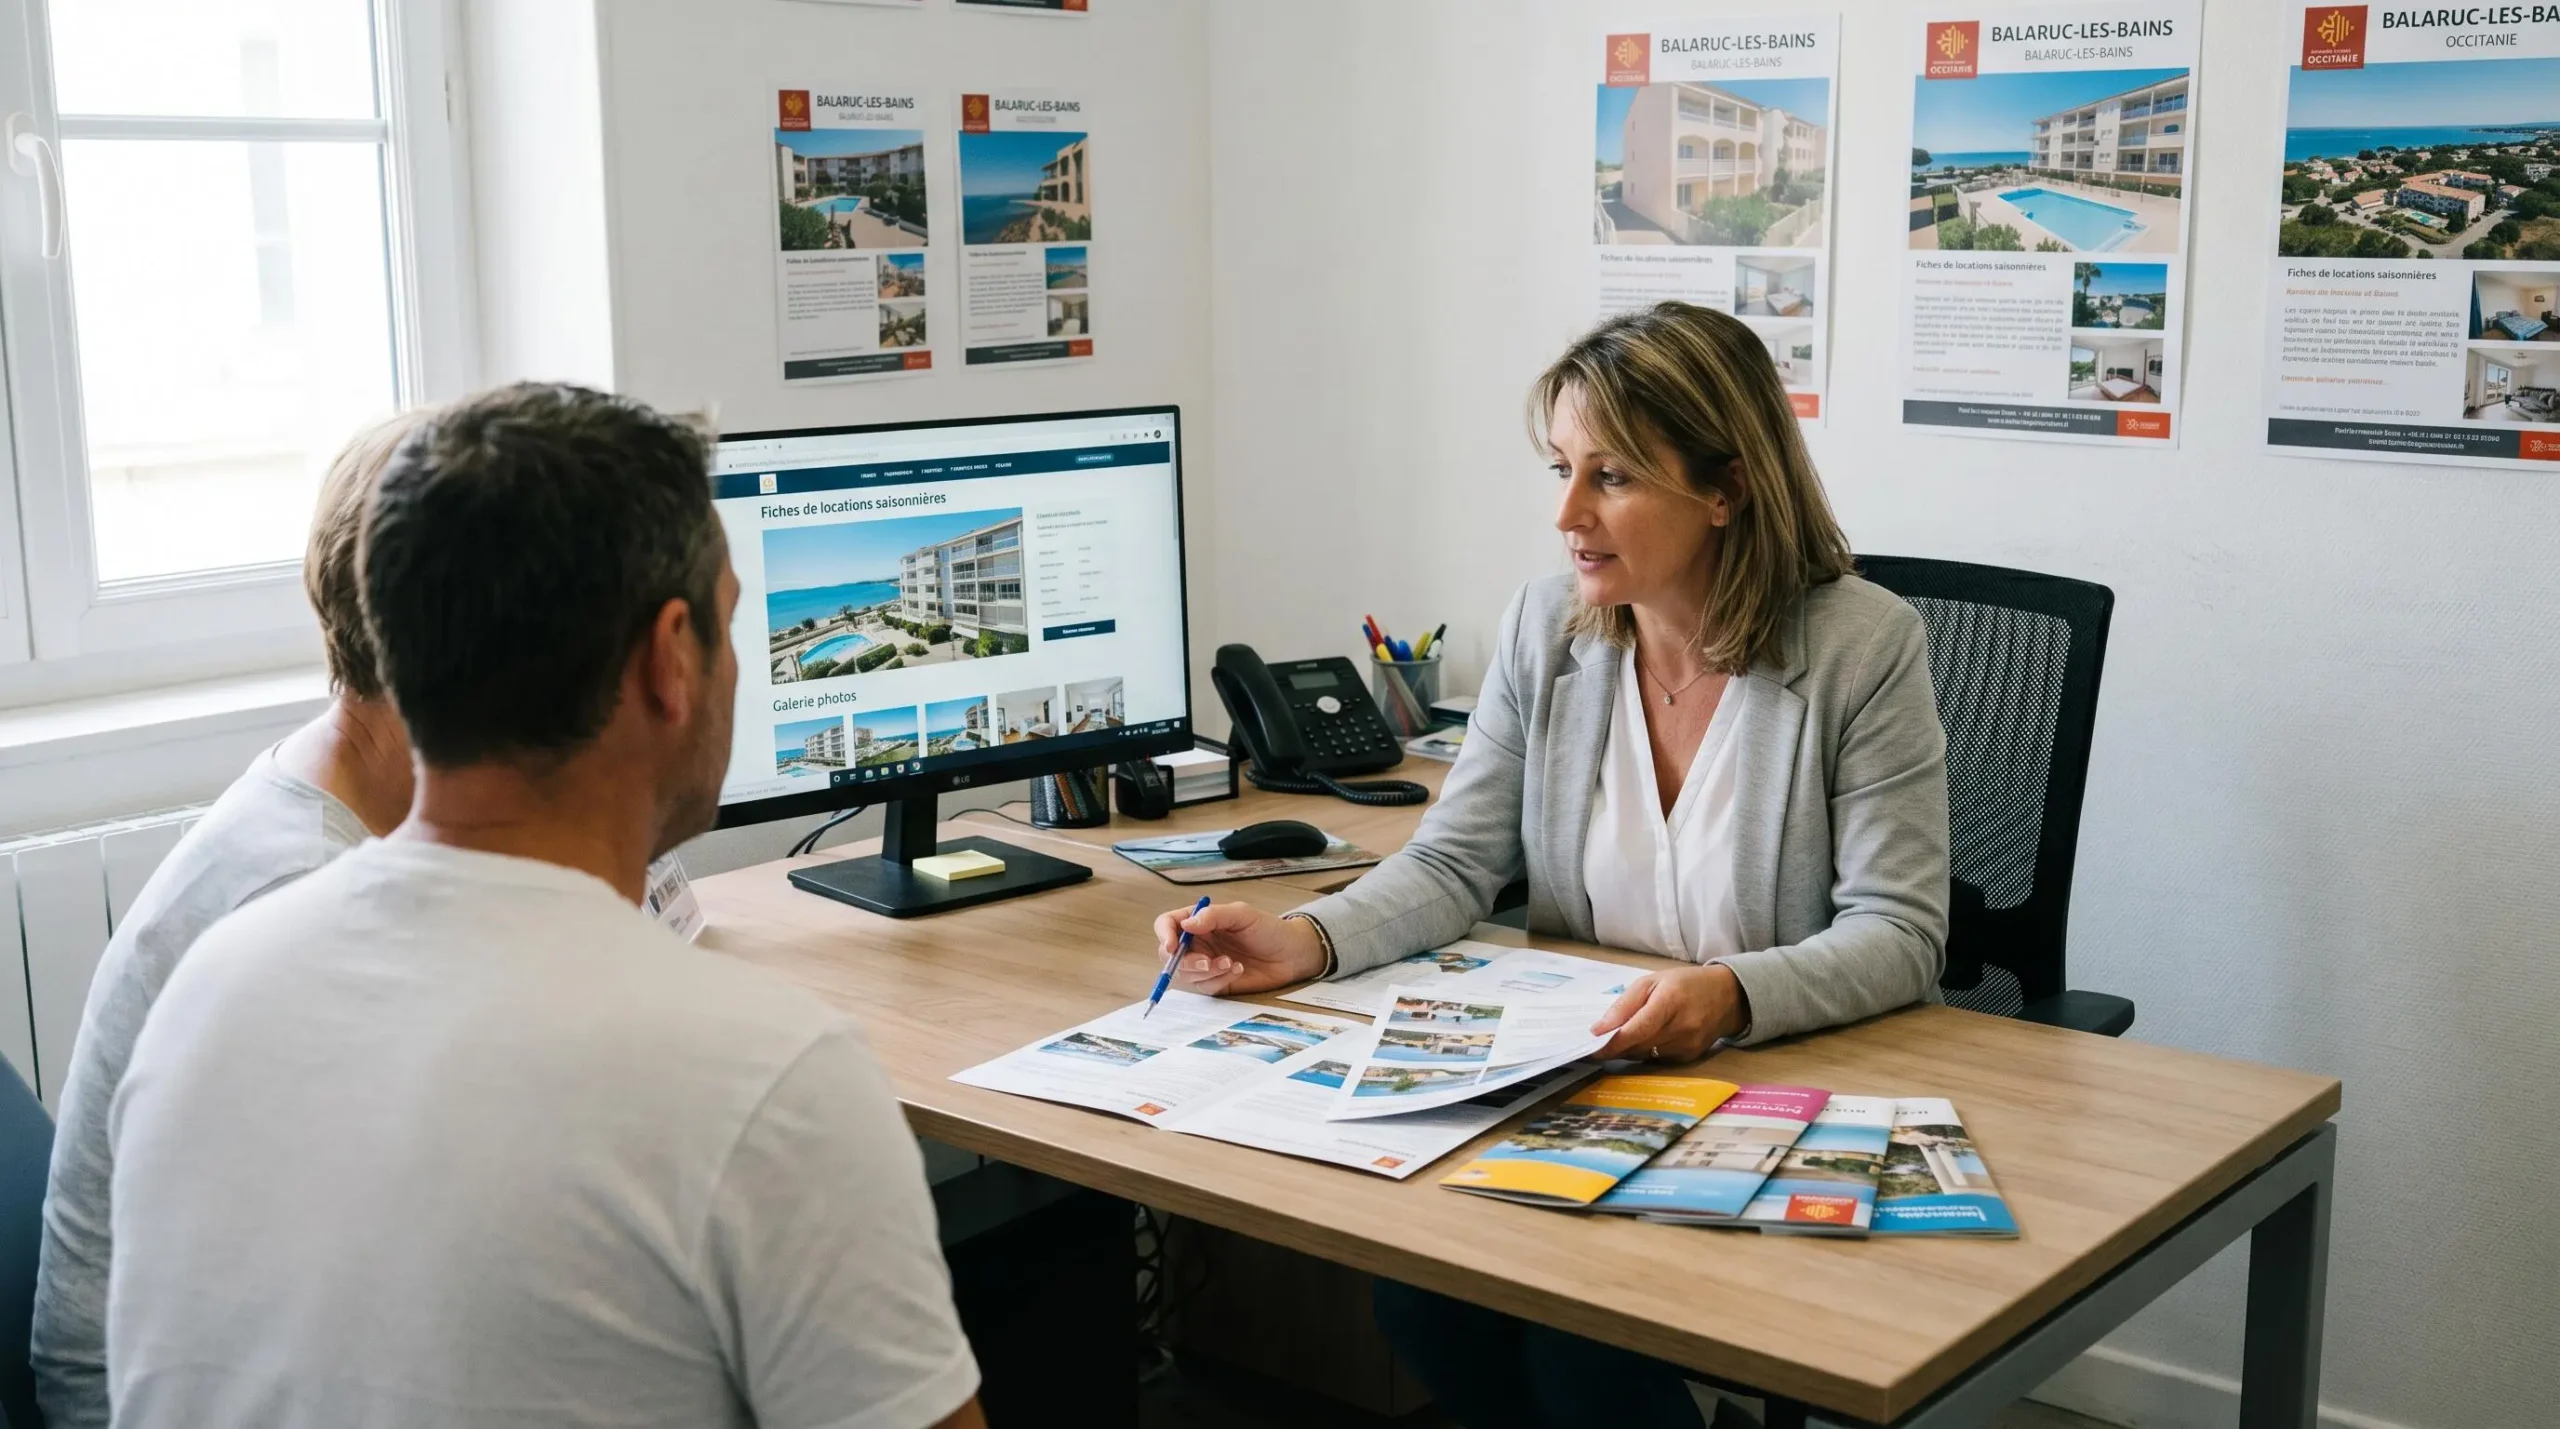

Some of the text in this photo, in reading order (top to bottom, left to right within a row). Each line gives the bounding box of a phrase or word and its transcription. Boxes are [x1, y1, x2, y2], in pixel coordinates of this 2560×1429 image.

[1992, 19, 2173, 42] BALARUC-LES-BAINS
[1661, 33, 1815, 53] BALARUC-LES-BAINS
[2445, 33, 2517, 48] OCCITANIE
[2024, 46, 2133, 61] BALARUC-LES-BAINS
[1691, 57, 1782, 70] BALARUC-LES-BAINS
[816, 95, 914, 109] BALARUC-LES-BAINS
[995, 99, 1080, 112] BALARUC-LES-BAINS
[1916, 260, 2047, 271] Fiches de locations saisonnières
[2287, 268, 2437, 280] Fiches de locations saisonnières
[761, 492, 947, 518] Fiches de locations saisonnières
[773, 692, 857, 712] Galerie photos
